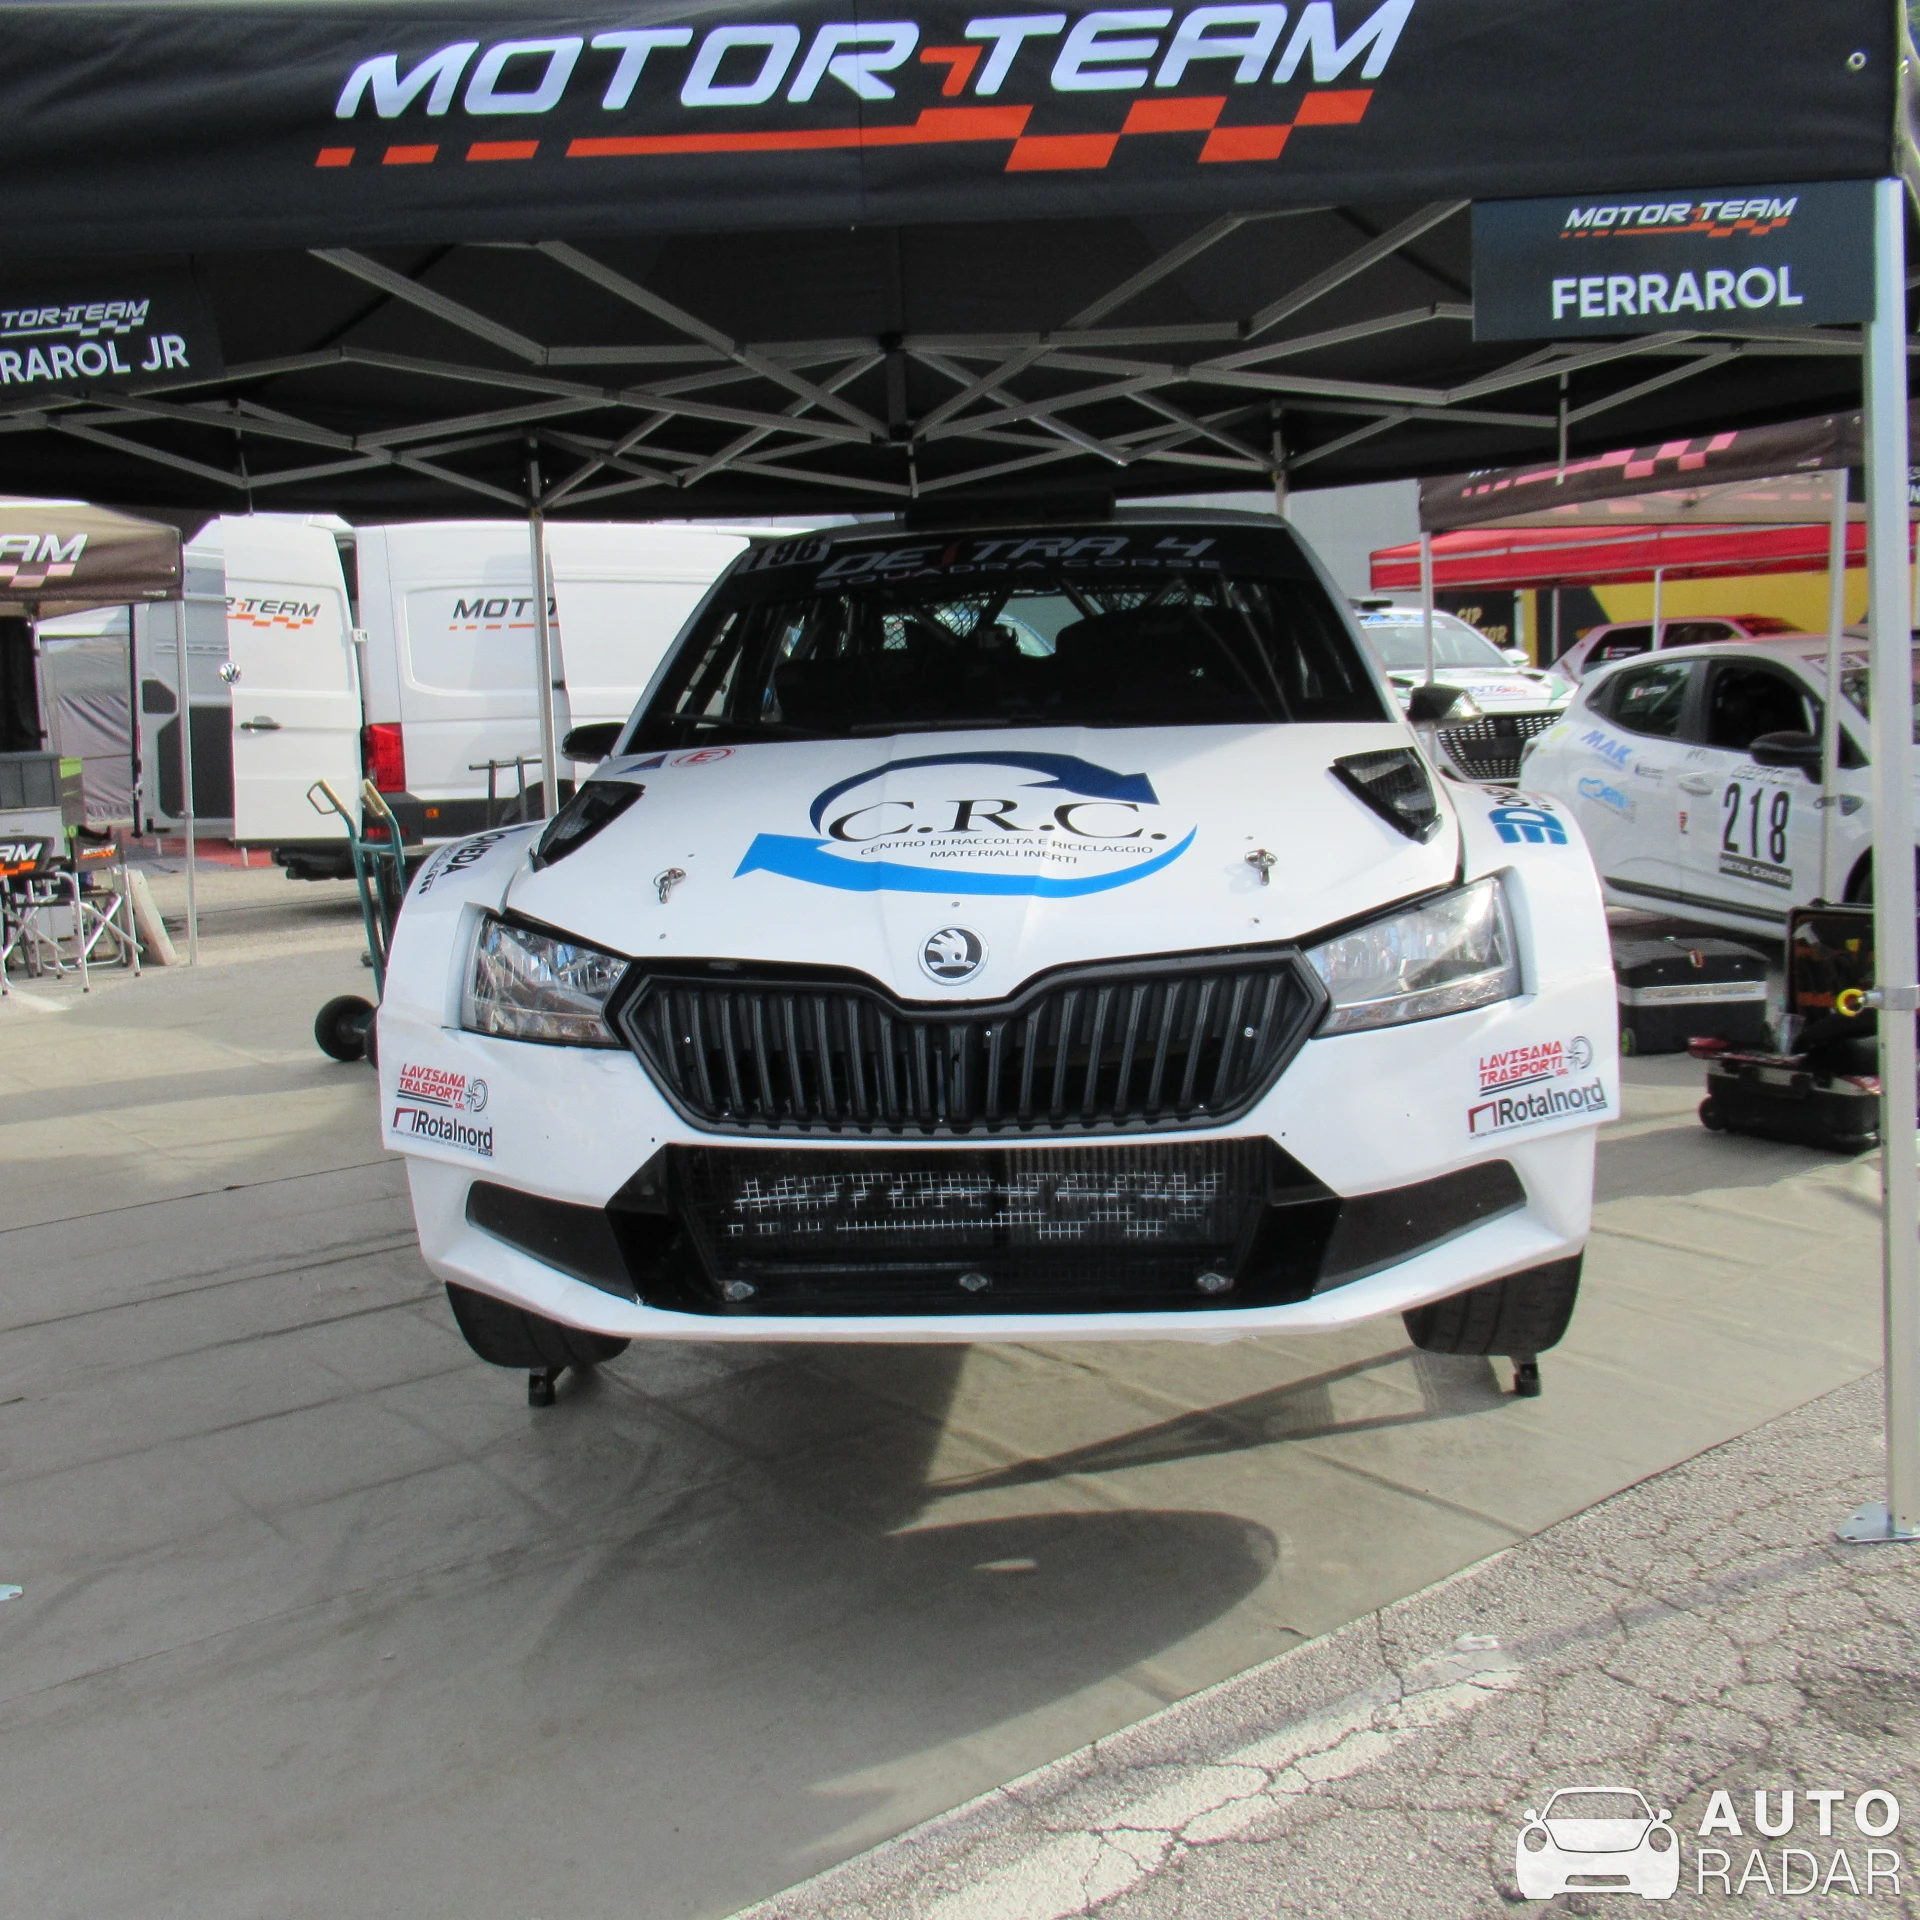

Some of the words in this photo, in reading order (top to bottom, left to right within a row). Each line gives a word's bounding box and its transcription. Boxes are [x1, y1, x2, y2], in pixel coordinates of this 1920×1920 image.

[336, 21, 919, 118] MOTOR
[964, 0, 1415, 95] TEAM
[1565, 202, 1692, 228] MOTOR
[1699, 197, 1798, 221] TEAM
[1552, 265, 1803, 320] FERRAROL
[67, 300, 150, 323] TEAM
[141, 334, 190, 371] JR
[1155, 538, 1216, 557] 4
[1062, 558, 1220, 569] CORSE
[245, 598, 321, 617] TEAM
[1581, 730, 1633, 763] MAK
[828, 799, 1167, 842] C.R.C.
[1723, 783, 1791, 864] 218
[860, 839, 925, 855] CENTRO
[930, 839, 946, 847] DI
[951, 837, 1034, 846] RACCOLTA
[1038, 838, 1047, 846] E
[1051, 840, 1153, 854] RICICLAGGIO
[929, 849, 1018, 859] MATERIALI
[1024, 850, 1078, 864] INERTI
[1479, 1055, 1563, 1086] TRASPORTI
[1480, 1040, 1563, 1070] LAVISANA
[399, 1077, 464, 1102] TRASPORTI
[401, 1063, 466, 1088] LAVISANA
[1498, 1077, 1606, 1125] Rotalnord
[415, 1109, 493, 1150] Rotalnord
